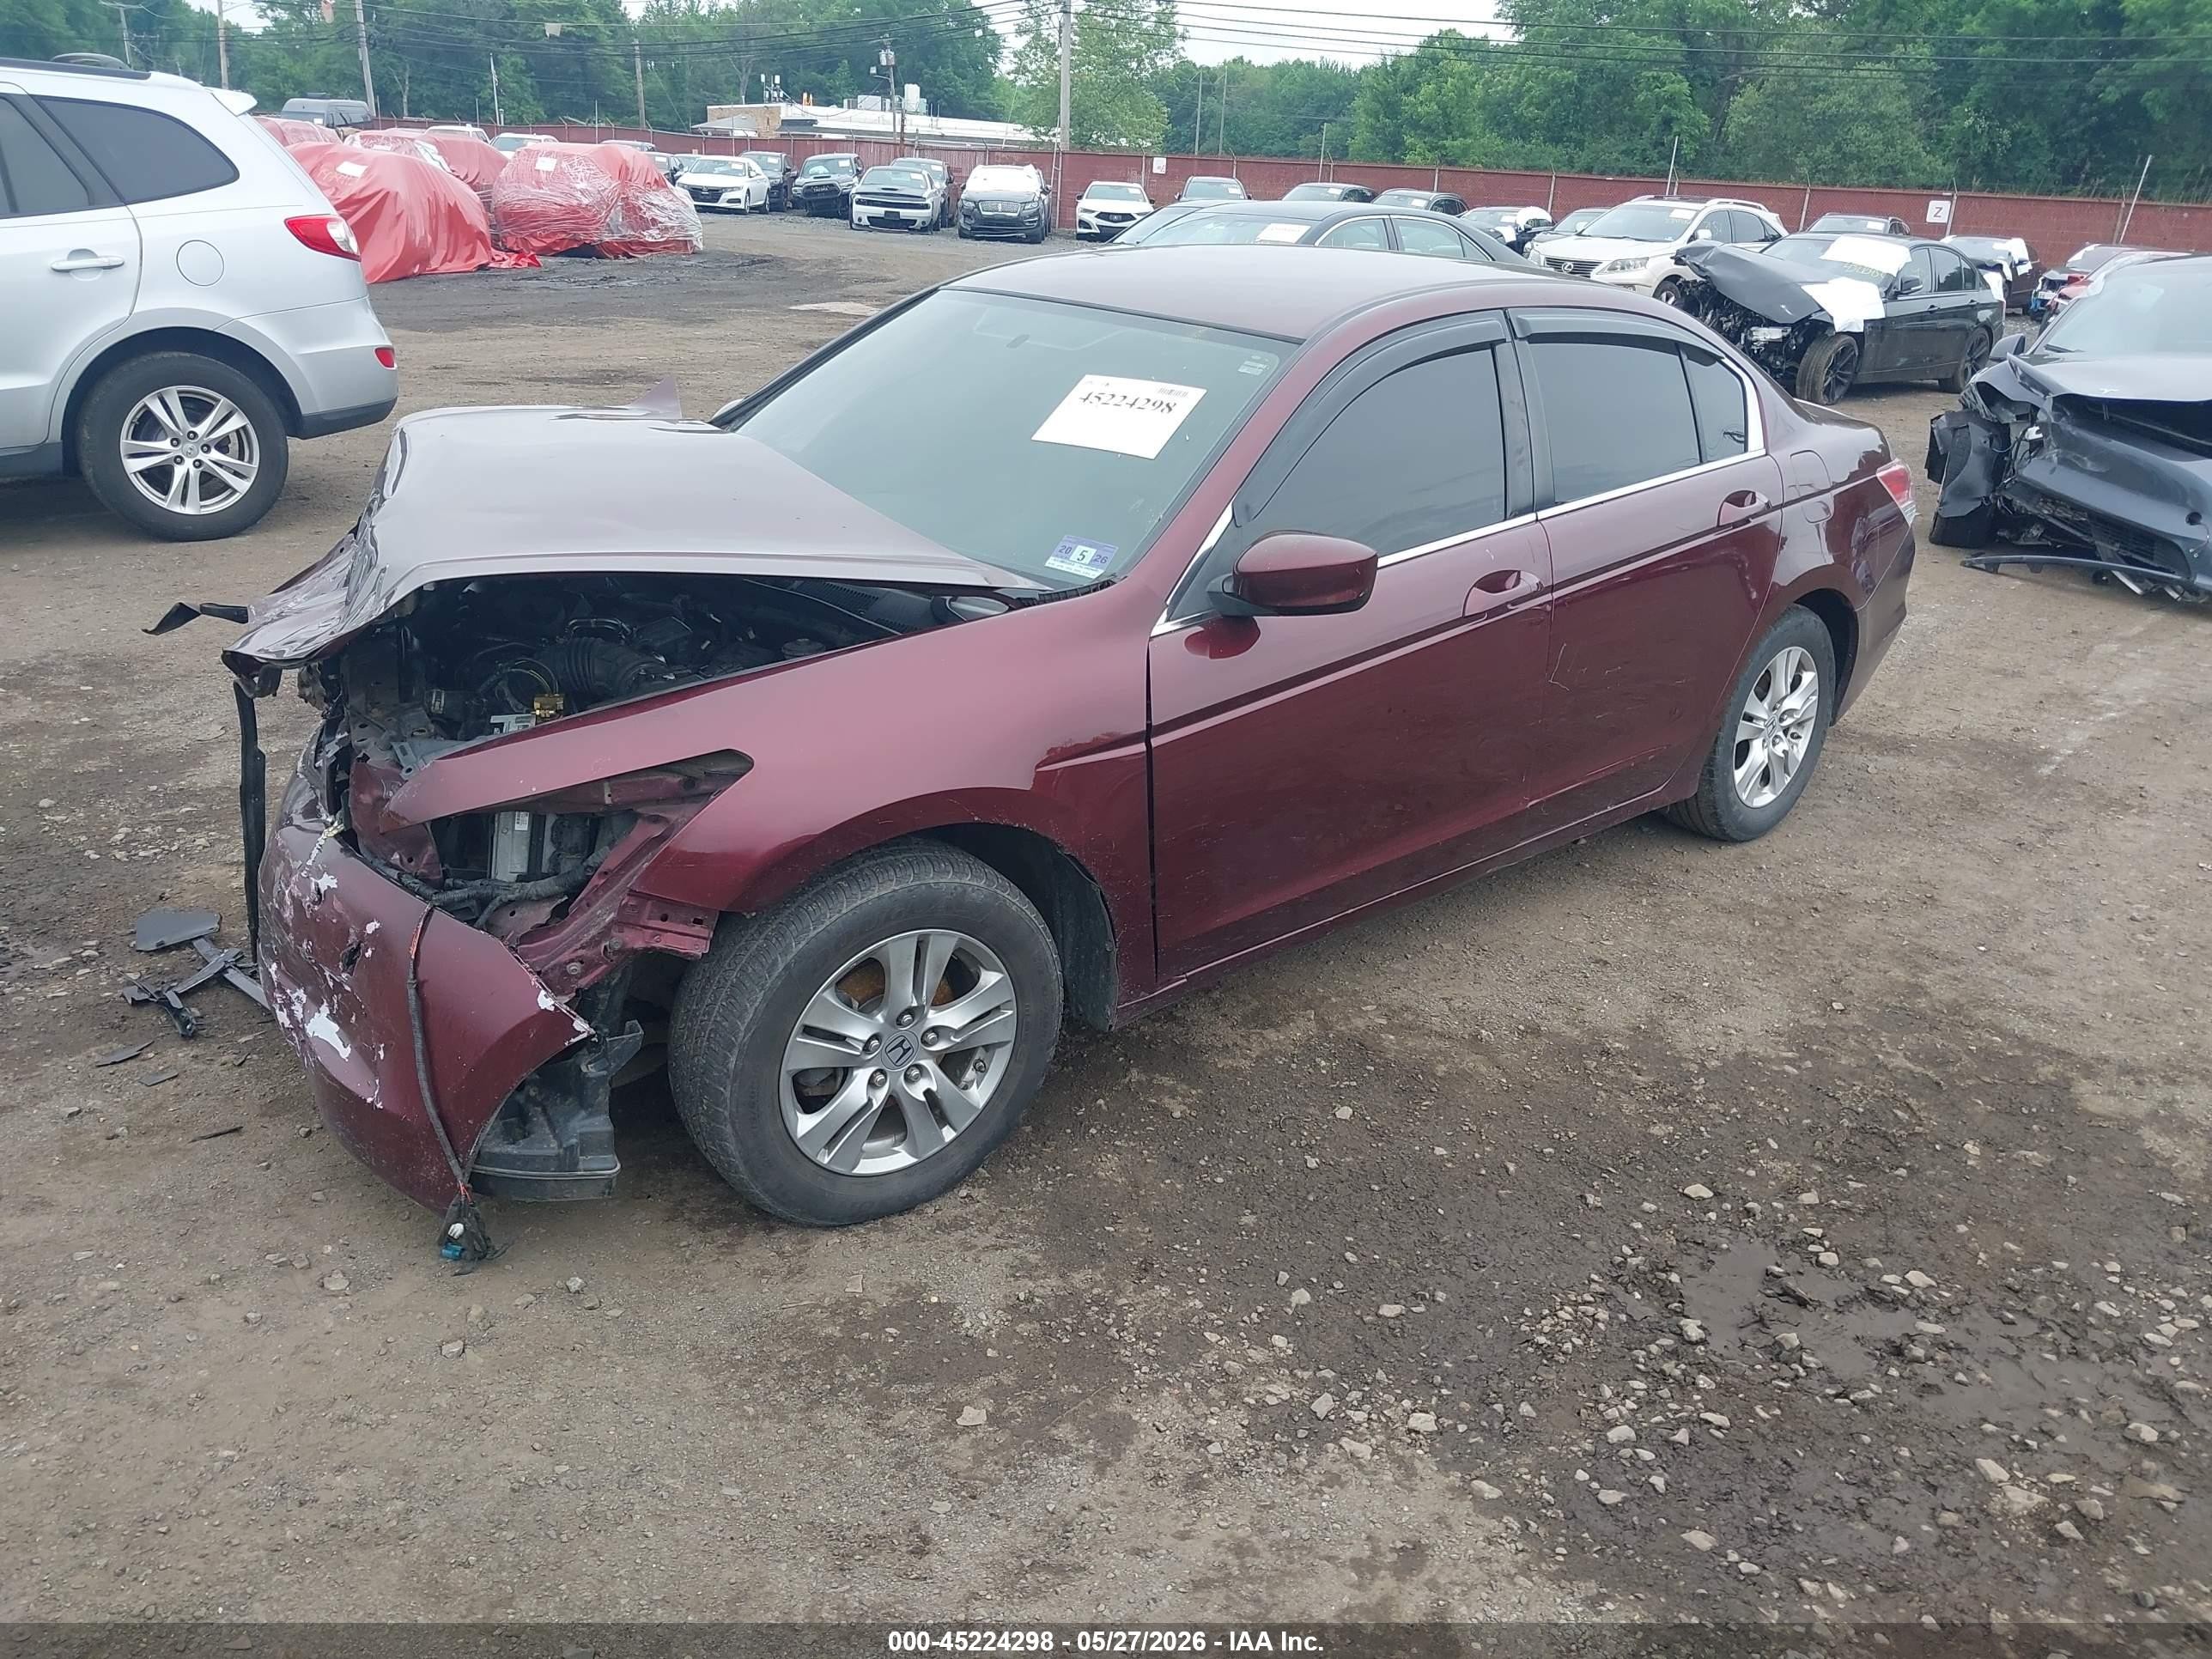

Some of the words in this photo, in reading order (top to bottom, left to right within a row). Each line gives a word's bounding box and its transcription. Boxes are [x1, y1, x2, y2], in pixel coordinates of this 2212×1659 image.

[1933, 206, 1943, 218] Z
[1079, 391, 1177, 414] 45224298
[1058, 544, 1073, 555] 20
[1077, 550, 1088, 562] 5
[1093, 555, 1109, 564] 26
